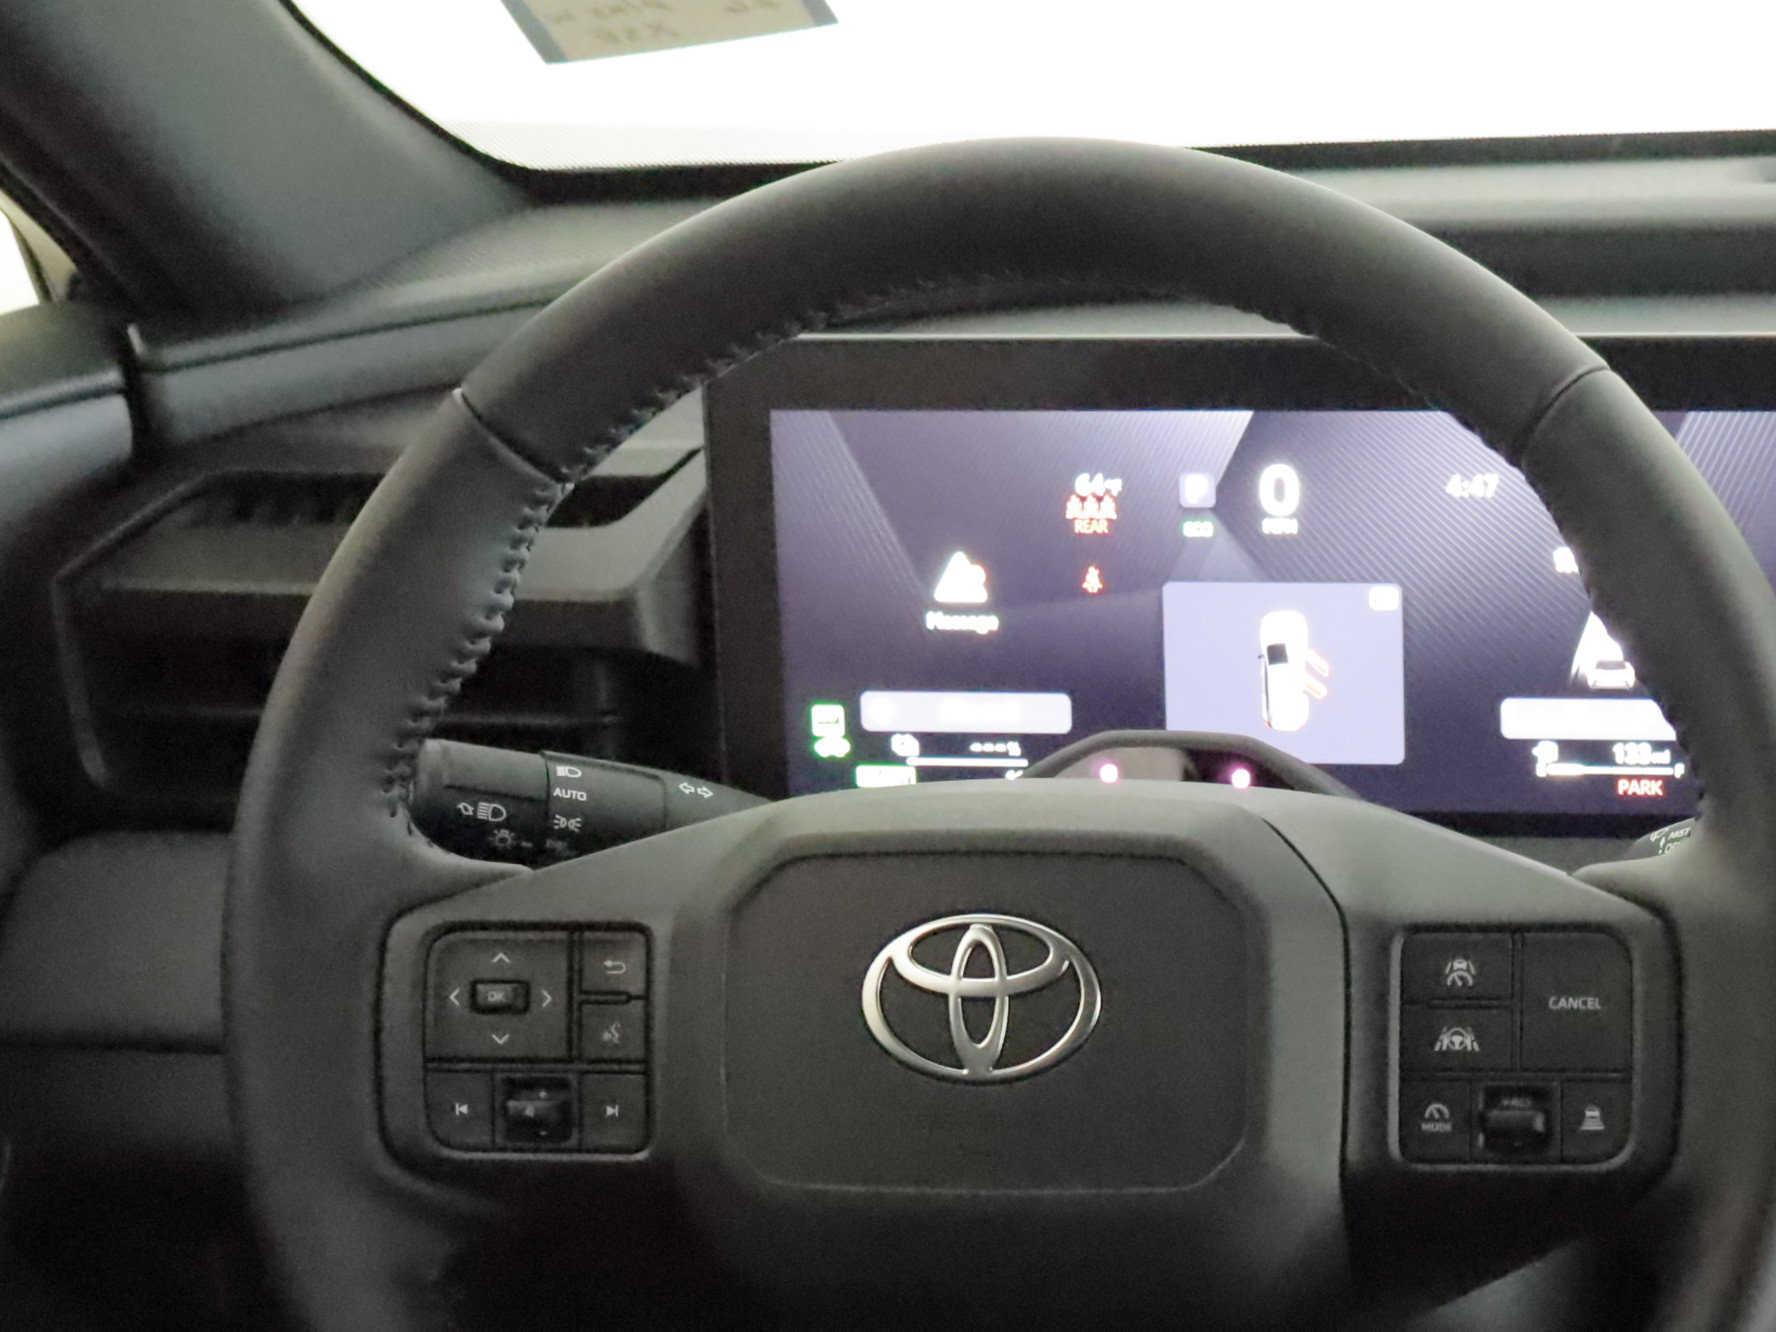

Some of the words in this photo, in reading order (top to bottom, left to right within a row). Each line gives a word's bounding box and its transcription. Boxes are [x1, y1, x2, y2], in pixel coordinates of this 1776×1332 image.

[1259, 463, 1301, 517] 0
[1445, 473, 1500, 498] 4:47
[1074, 519, 1109, 534] REAR
[553, 787, 587, 801] AUTO
[1617, 778, 1664, 796] PARK
[1548, 996, 1602, 1011] CANCEL
[1421, 1121, 1453, 1133] MODE
